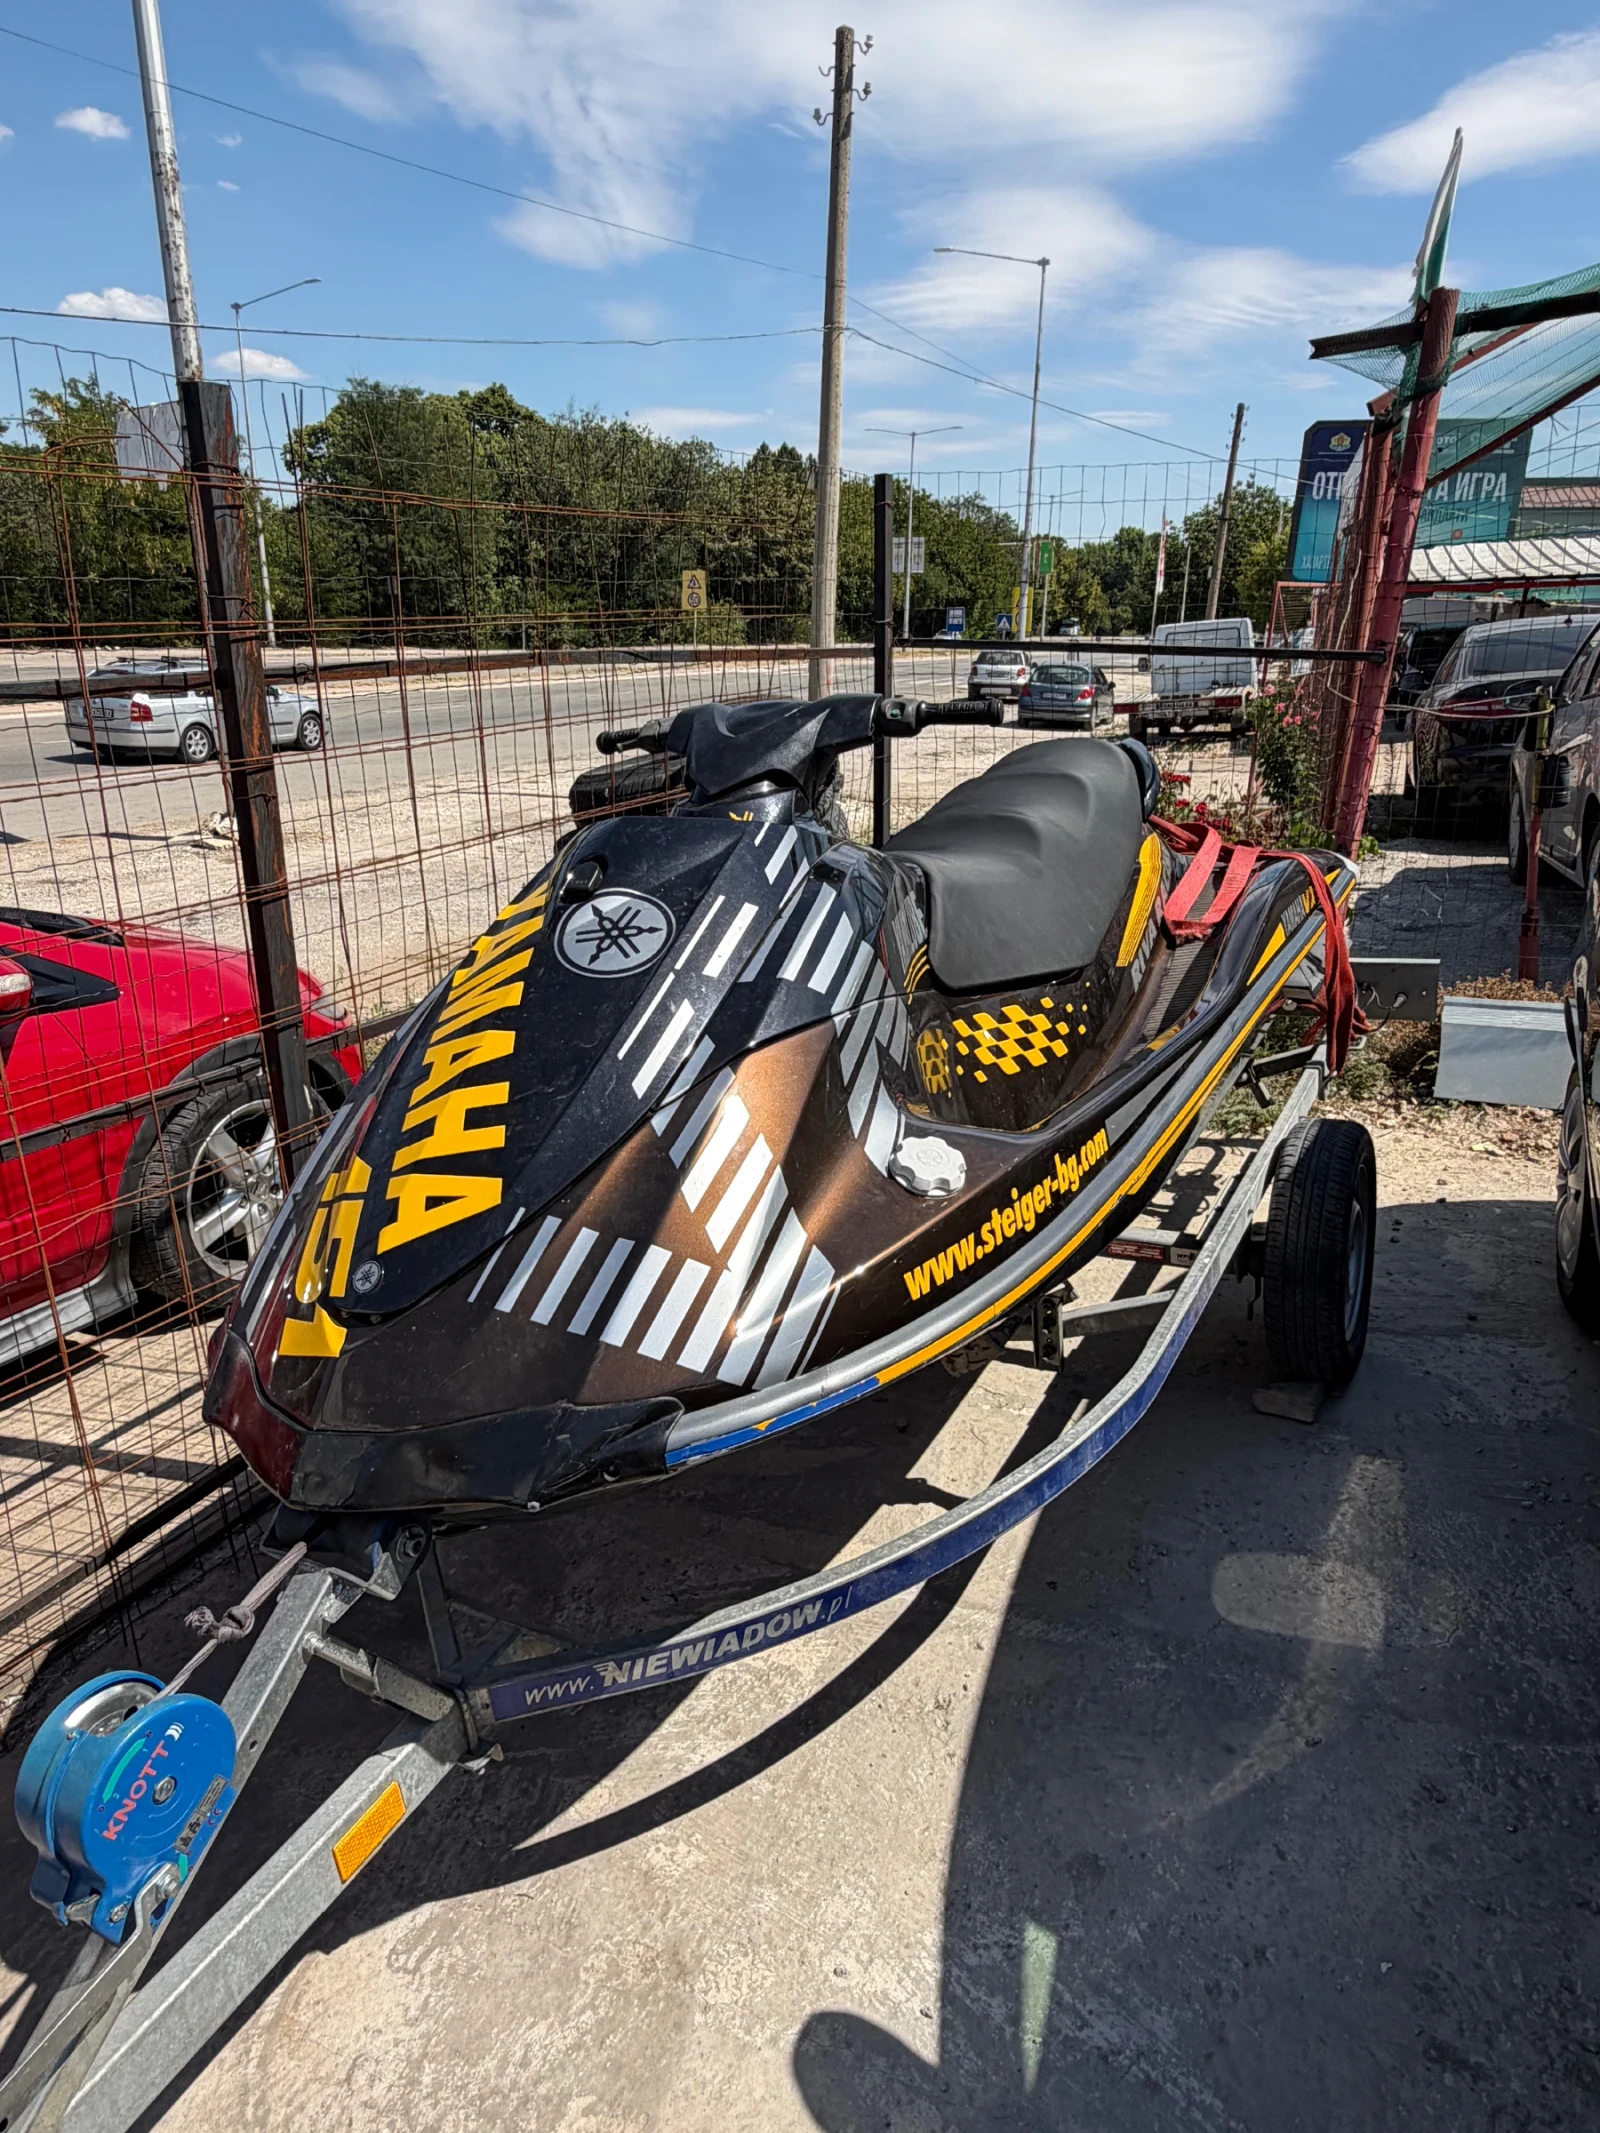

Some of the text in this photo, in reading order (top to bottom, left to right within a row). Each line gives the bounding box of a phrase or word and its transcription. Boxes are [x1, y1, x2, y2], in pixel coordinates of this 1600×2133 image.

[1454, 471, 1507, 503] ИГРА
[376, 880, 548, 1256] YAMAHA
[278, 1154, 373, 1358] 151
[903, 1127, 1109, 1301] www.steiger-bg.com
[102, 1739, 169, 1841] KNOTT
